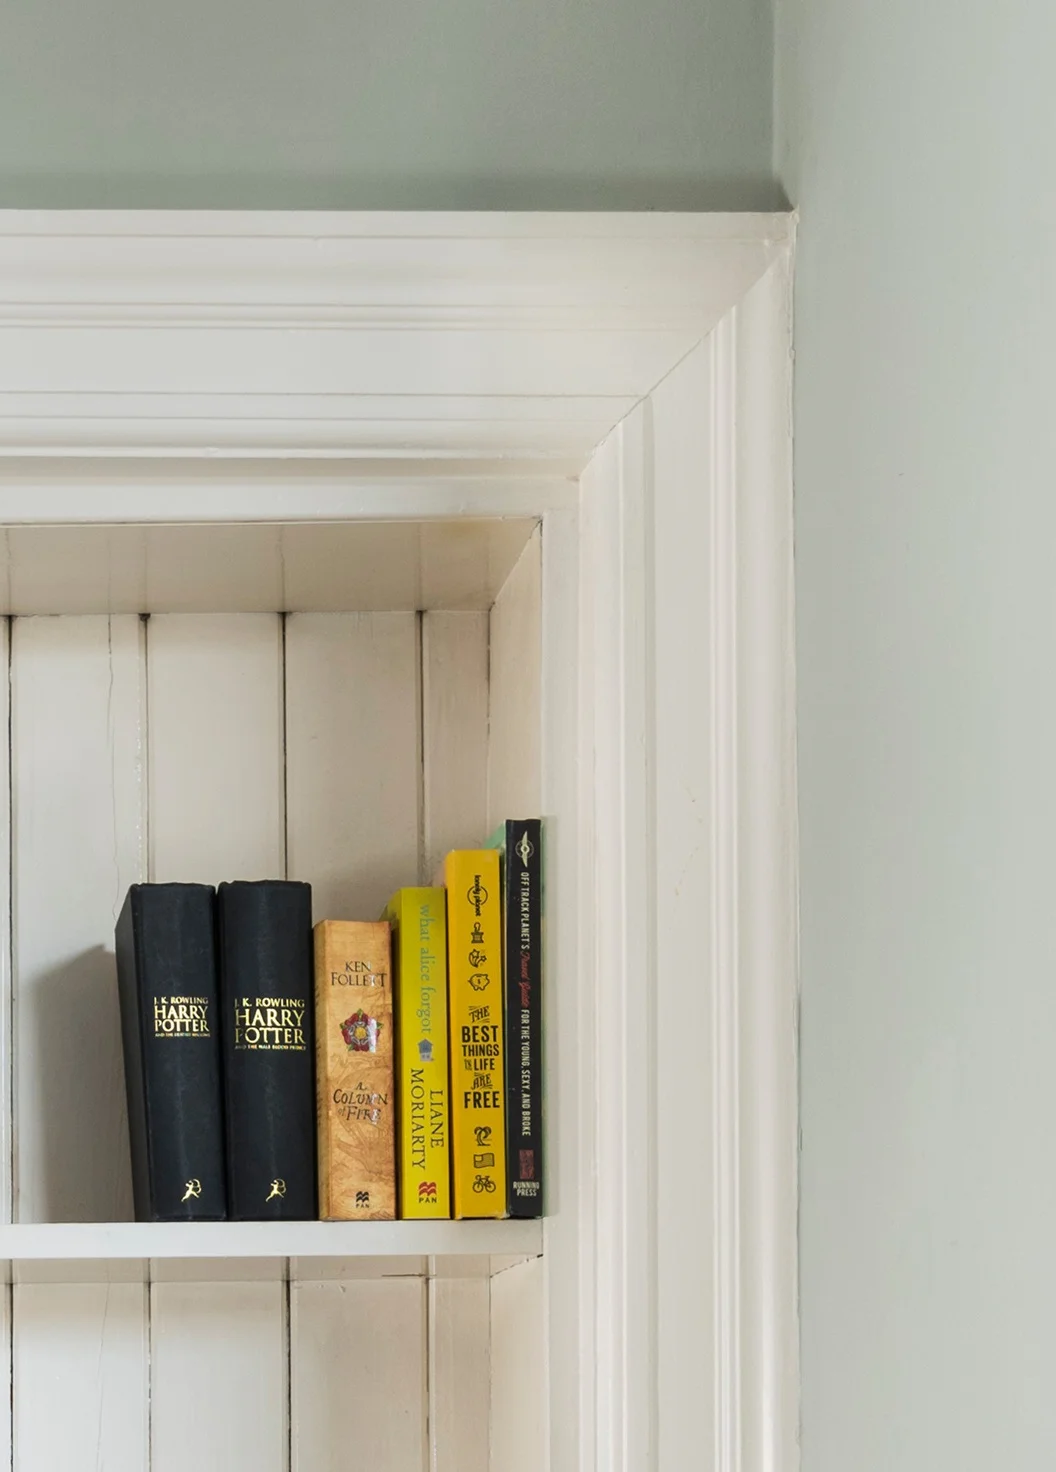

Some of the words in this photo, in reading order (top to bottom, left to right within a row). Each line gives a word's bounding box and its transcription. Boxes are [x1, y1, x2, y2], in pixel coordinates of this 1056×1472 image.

[473, 875, 481, 894] lonely
[520, 872, 530, 886] OFF
[473, 896, 482, 916] planet
[521, 886, 530, 913] TRACK
[419, 904, 435, 941] what
[521, 913, 530, 950] PLANET'S
[345, 961, 371, 972] KEN
[420, 947, 436, 981] alice
[331, 973, 388, 987] FOLLETT
[242, 998, 252, 1007] K.
[256, 997, 305, 1007] ROWLING
[417, 986, 436, 1033] forgot
[154, 1005, 208, 1019] HARRY
[235, 1008, 305, 1026] HARRY
[469, 1006, 490, 1023] THE
[520, 1009, 530, 1024] FOR
[154, 1019, 210, 1032] POTTER
[461, 1025, 499, 1043] BEST
[521, 1025, 530, 1040] THE
[235, 1027, 306, 1044] POTTER
[461, 1043, 500, 1057] THINGS
[473, 1058, 495, 1071] LIFE
[471, 1073, 492, 1090] ARE
[464, 1091, 501, 1109] FREE
[521, 1093, 531, 1109] AND
[410, 1068, 426, 1170] MORIARTY
[430, 1089, 444, 1148] LIANE
[521, 1111, 532, 1136] BROKE
[516, 1188, 537, 1197] PRESS
